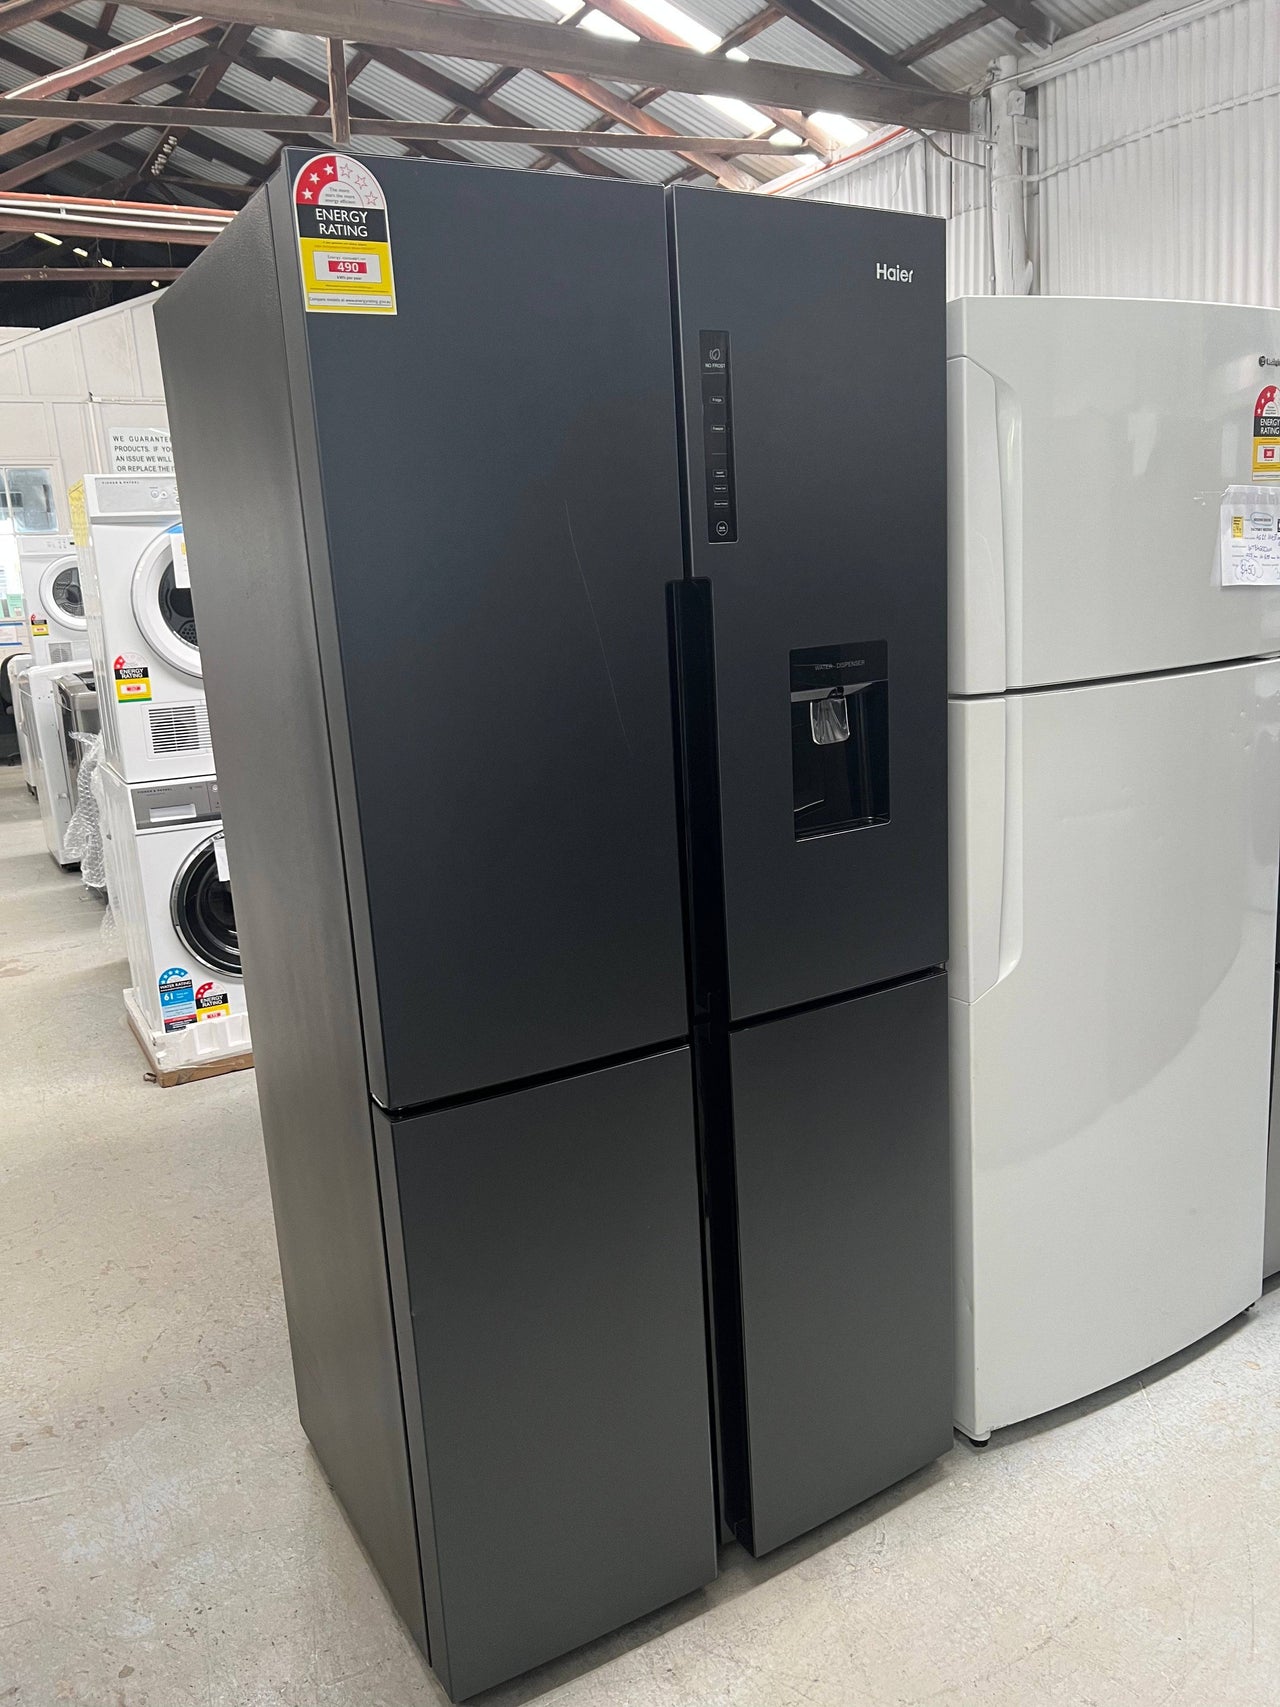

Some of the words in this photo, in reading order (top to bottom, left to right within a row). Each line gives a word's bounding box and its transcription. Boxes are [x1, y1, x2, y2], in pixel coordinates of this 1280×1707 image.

[315, 208, 368, 224] ENERGY
[319, 223, 368, 237] RATING
[337, 262, 359, 272] 490
[876, 262, 914, 283] Haier
[1260, 427, 1280, 435] RATING
[836, 660, 865, 669] DISPENSER
[201, 995, 223, 1003] ENERGY
[202, 1000, 223, 1008] RATING
